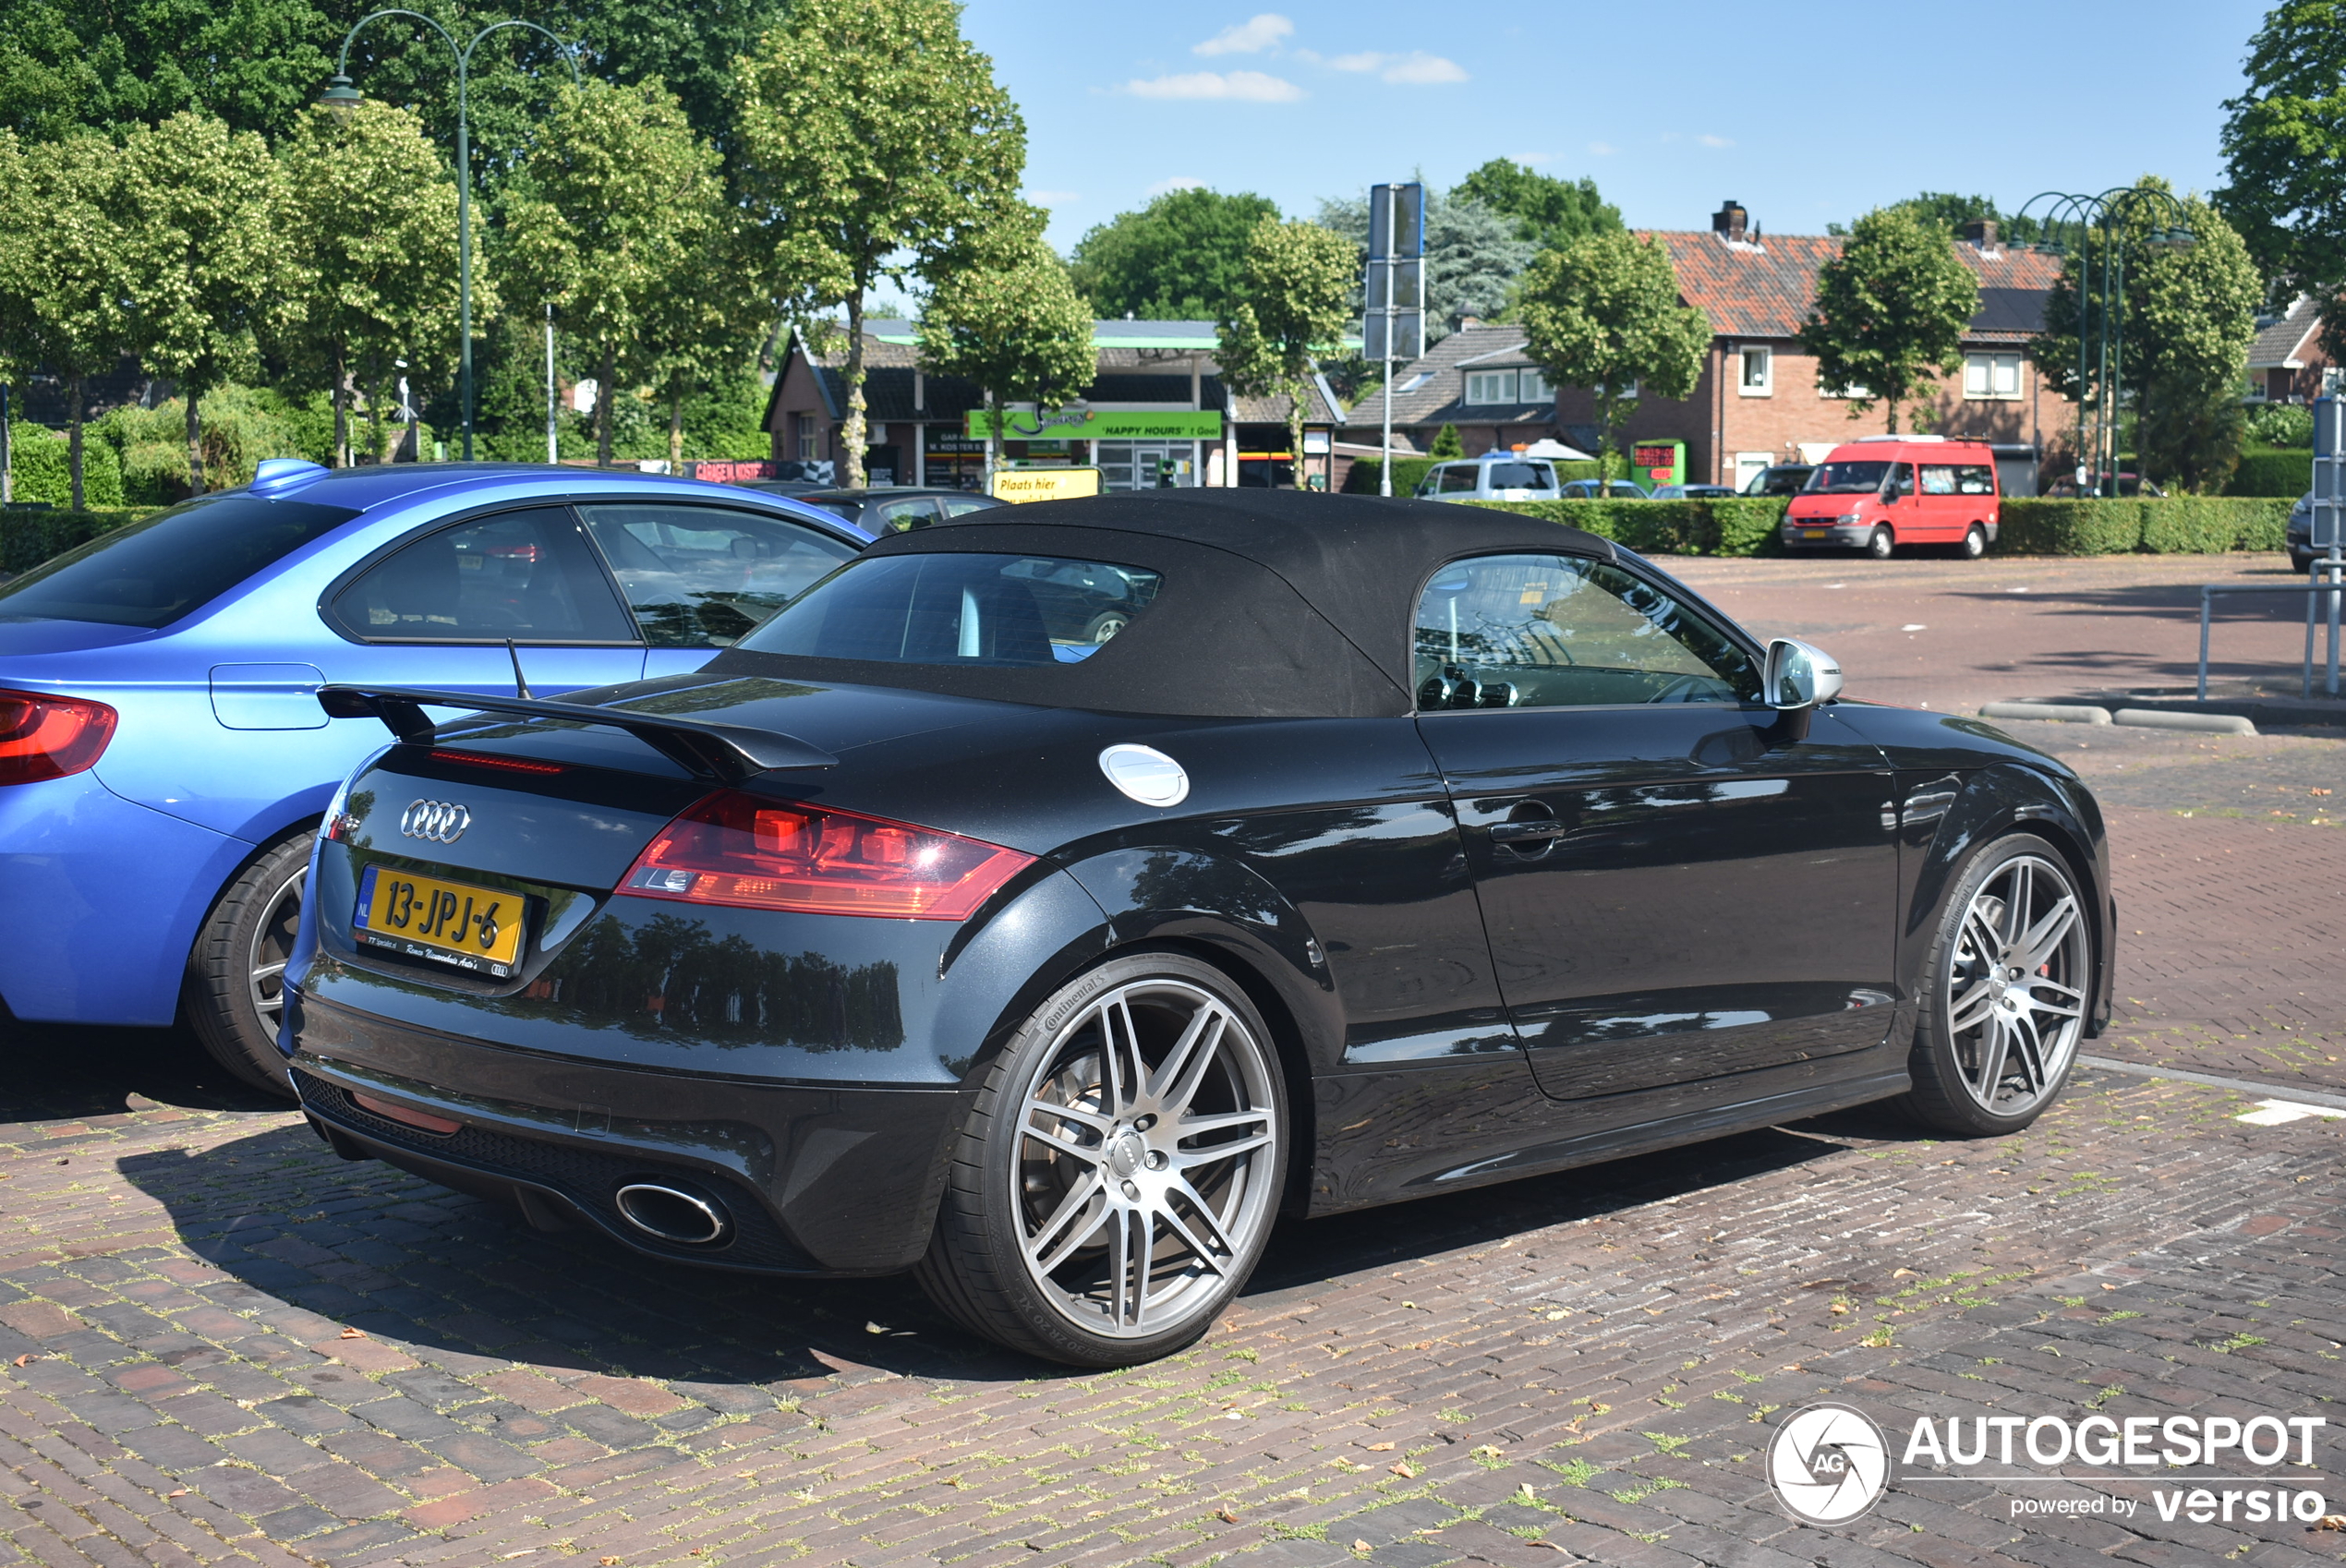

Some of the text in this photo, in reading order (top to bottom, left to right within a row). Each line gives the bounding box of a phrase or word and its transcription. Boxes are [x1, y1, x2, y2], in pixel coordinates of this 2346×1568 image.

[1000, 477, 1056, 491] Plaats hier
[357, 903, 369, 918] NL
[385, 880, 501, 950] 13-JPJ-6
[1946, 889, 1970, 940] Continental
[369, 935, 377, 945] TT
[1045, 979, 1098, 1031] Continental
